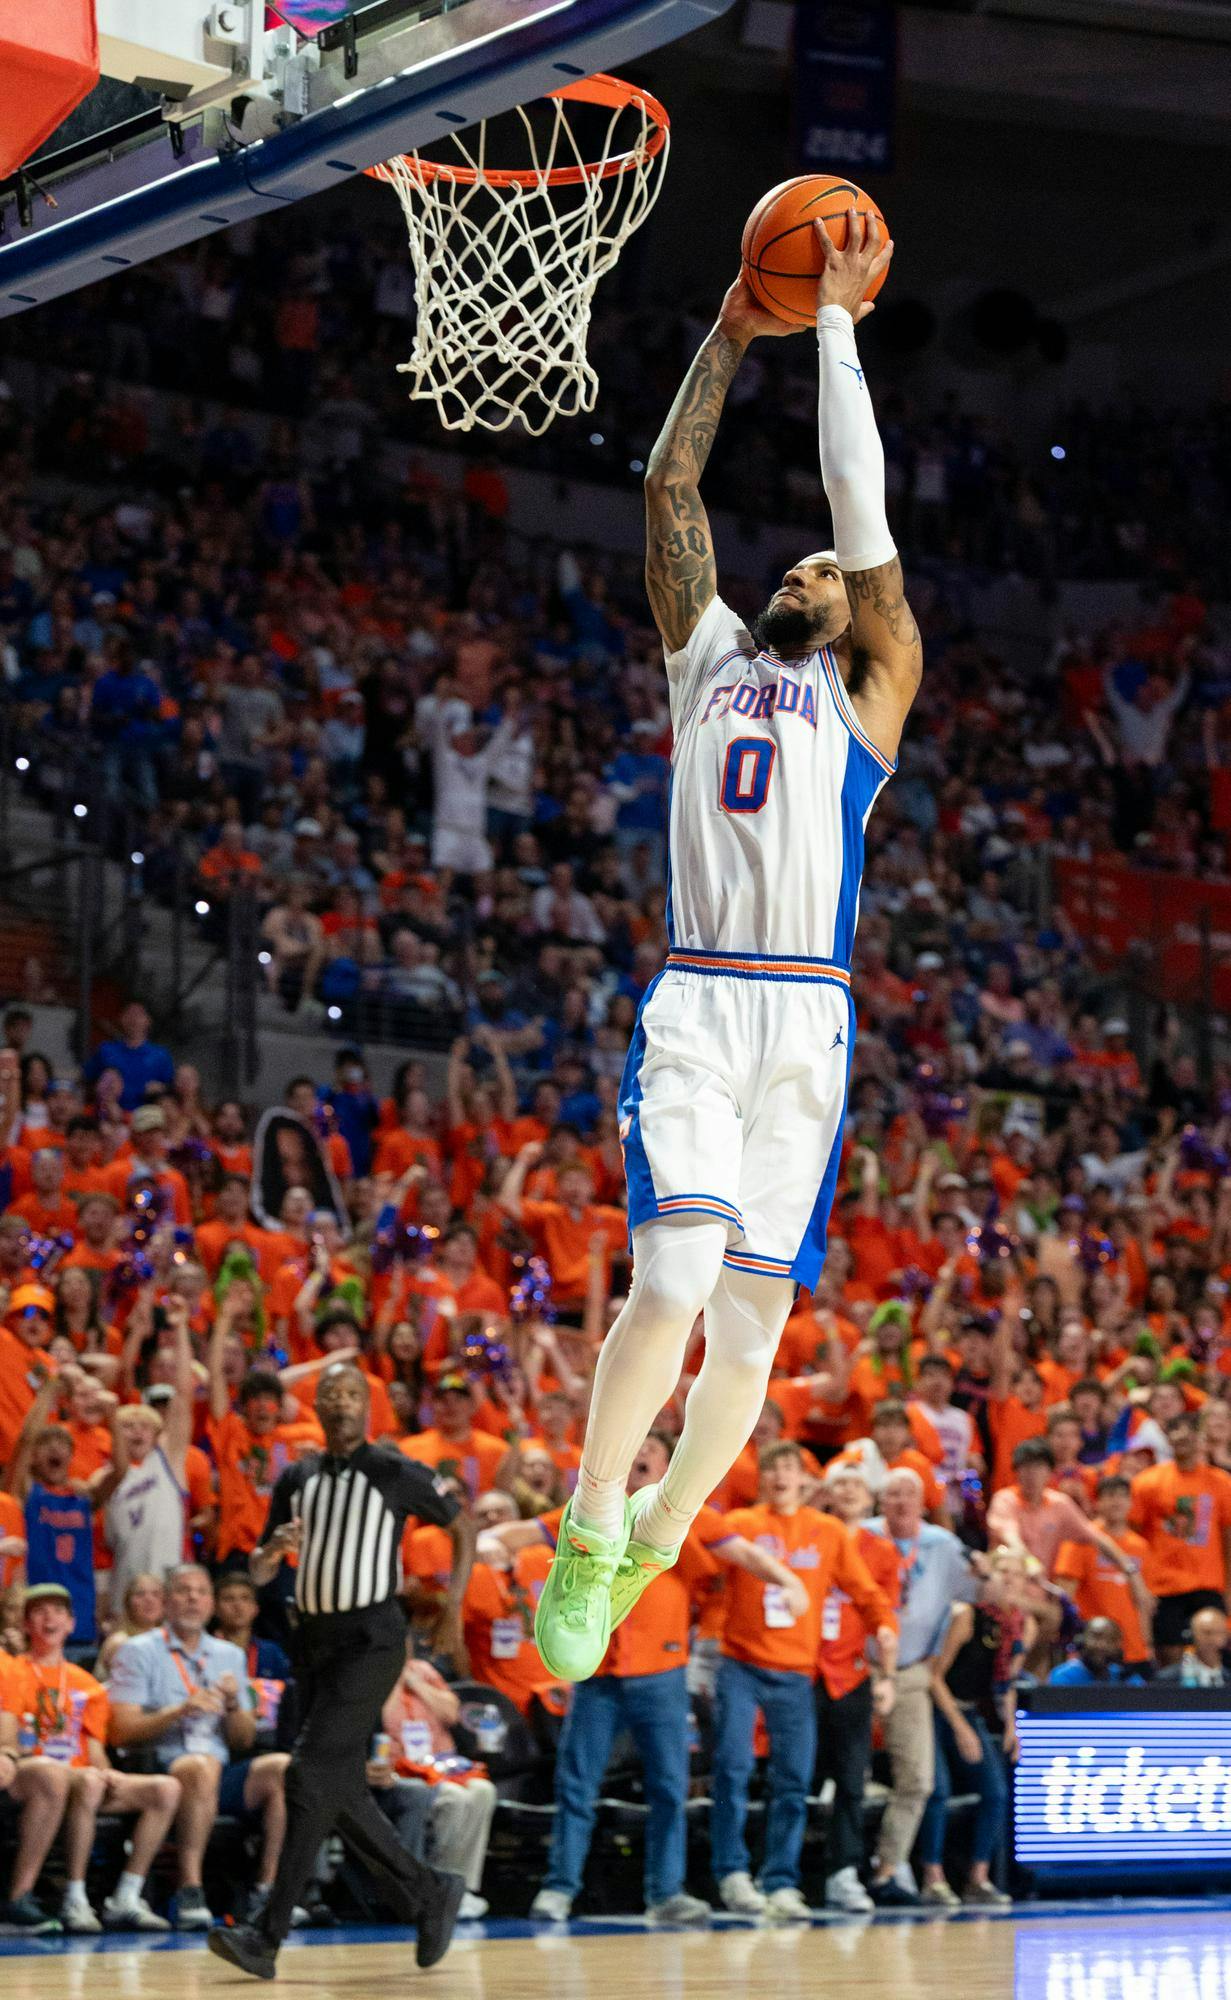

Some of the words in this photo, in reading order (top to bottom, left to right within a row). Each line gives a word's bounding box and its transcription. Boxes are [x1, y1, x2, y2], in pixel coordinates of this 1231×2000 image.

[698, 674, 817, 730] FORDA
[720, 736, 776, 814] 0
[1040, 1747, 1231, 1834] ticket
